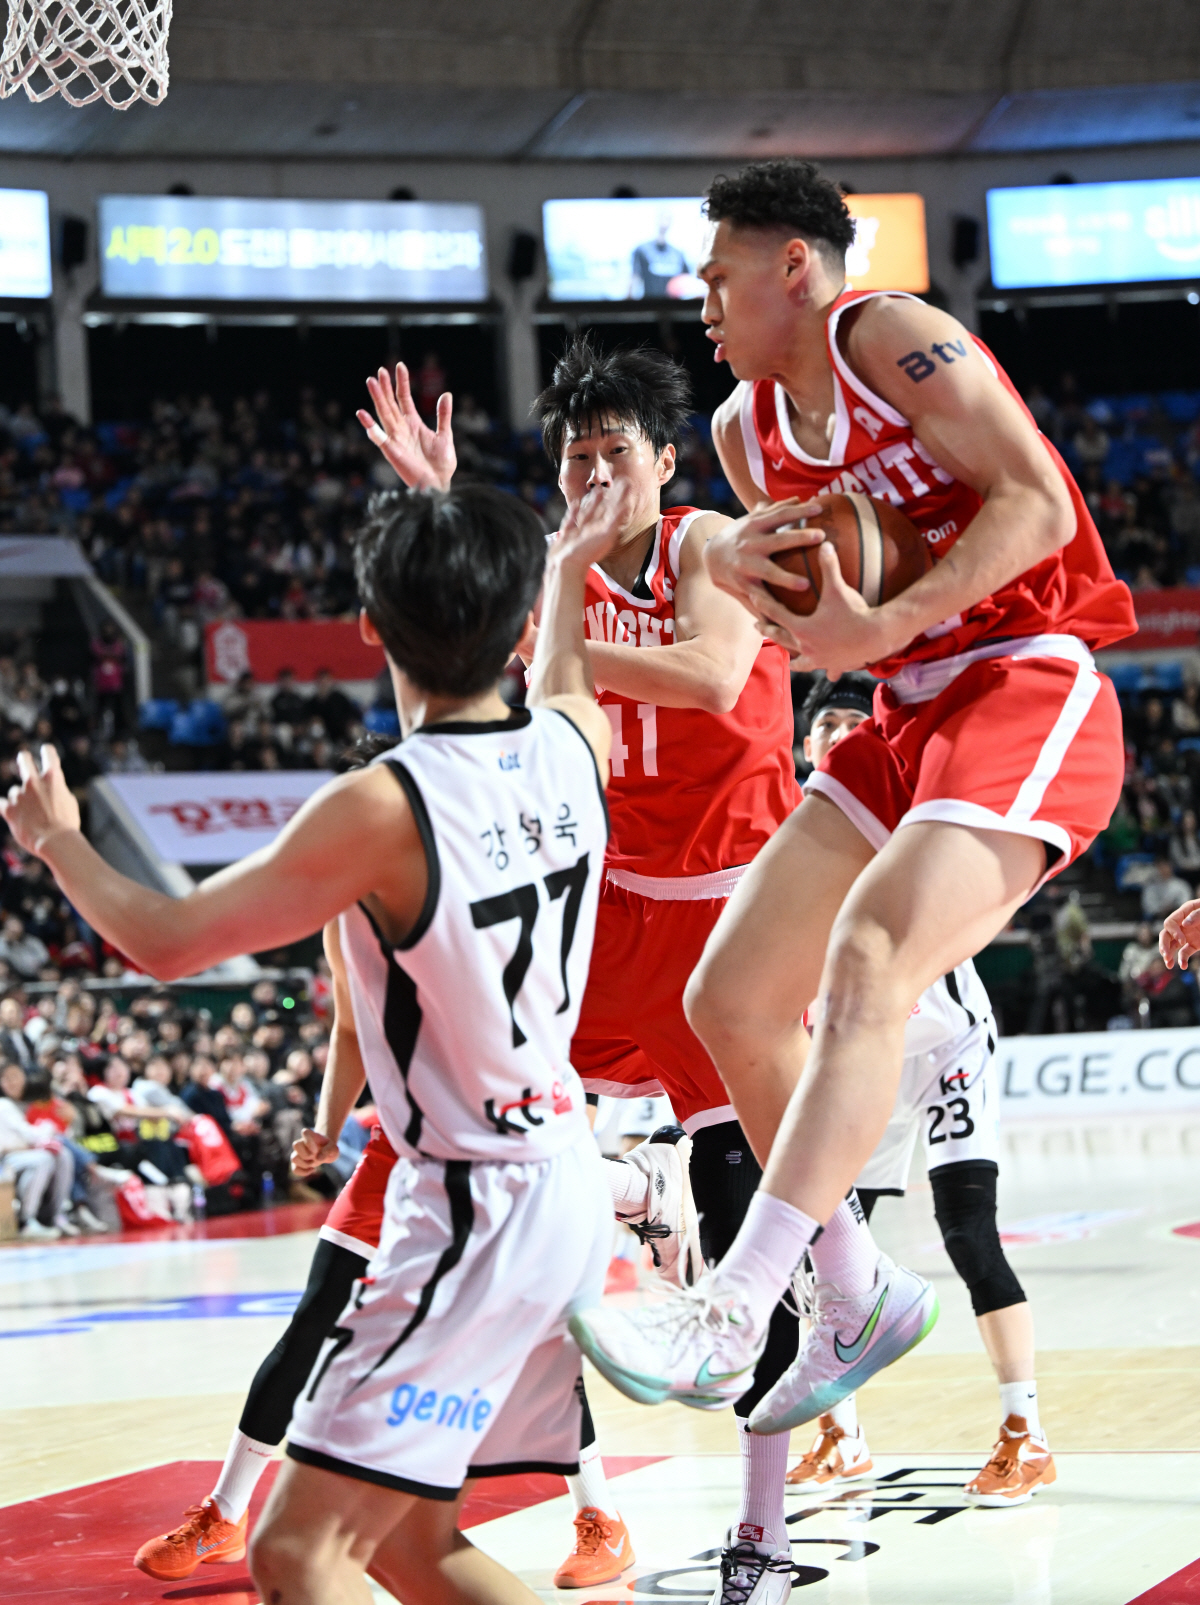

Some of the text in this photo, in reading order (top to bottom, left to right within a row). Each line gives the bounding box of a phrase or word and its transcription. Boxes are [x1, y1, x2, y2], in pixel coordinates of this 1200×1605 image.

[600, 703, 659, 777] 41
[480, 802, 579, 871] 강성욱
[469, 851, 591, 1049] 77
[939, 1067, 970, 1096] kt
[1003, 1047, 1200, 1099] LGE.CO
[484, 1086, 545, 1135] kt
[927, 1096, 975, 1146] 23
[386, 1382, 492, 1432] genie
